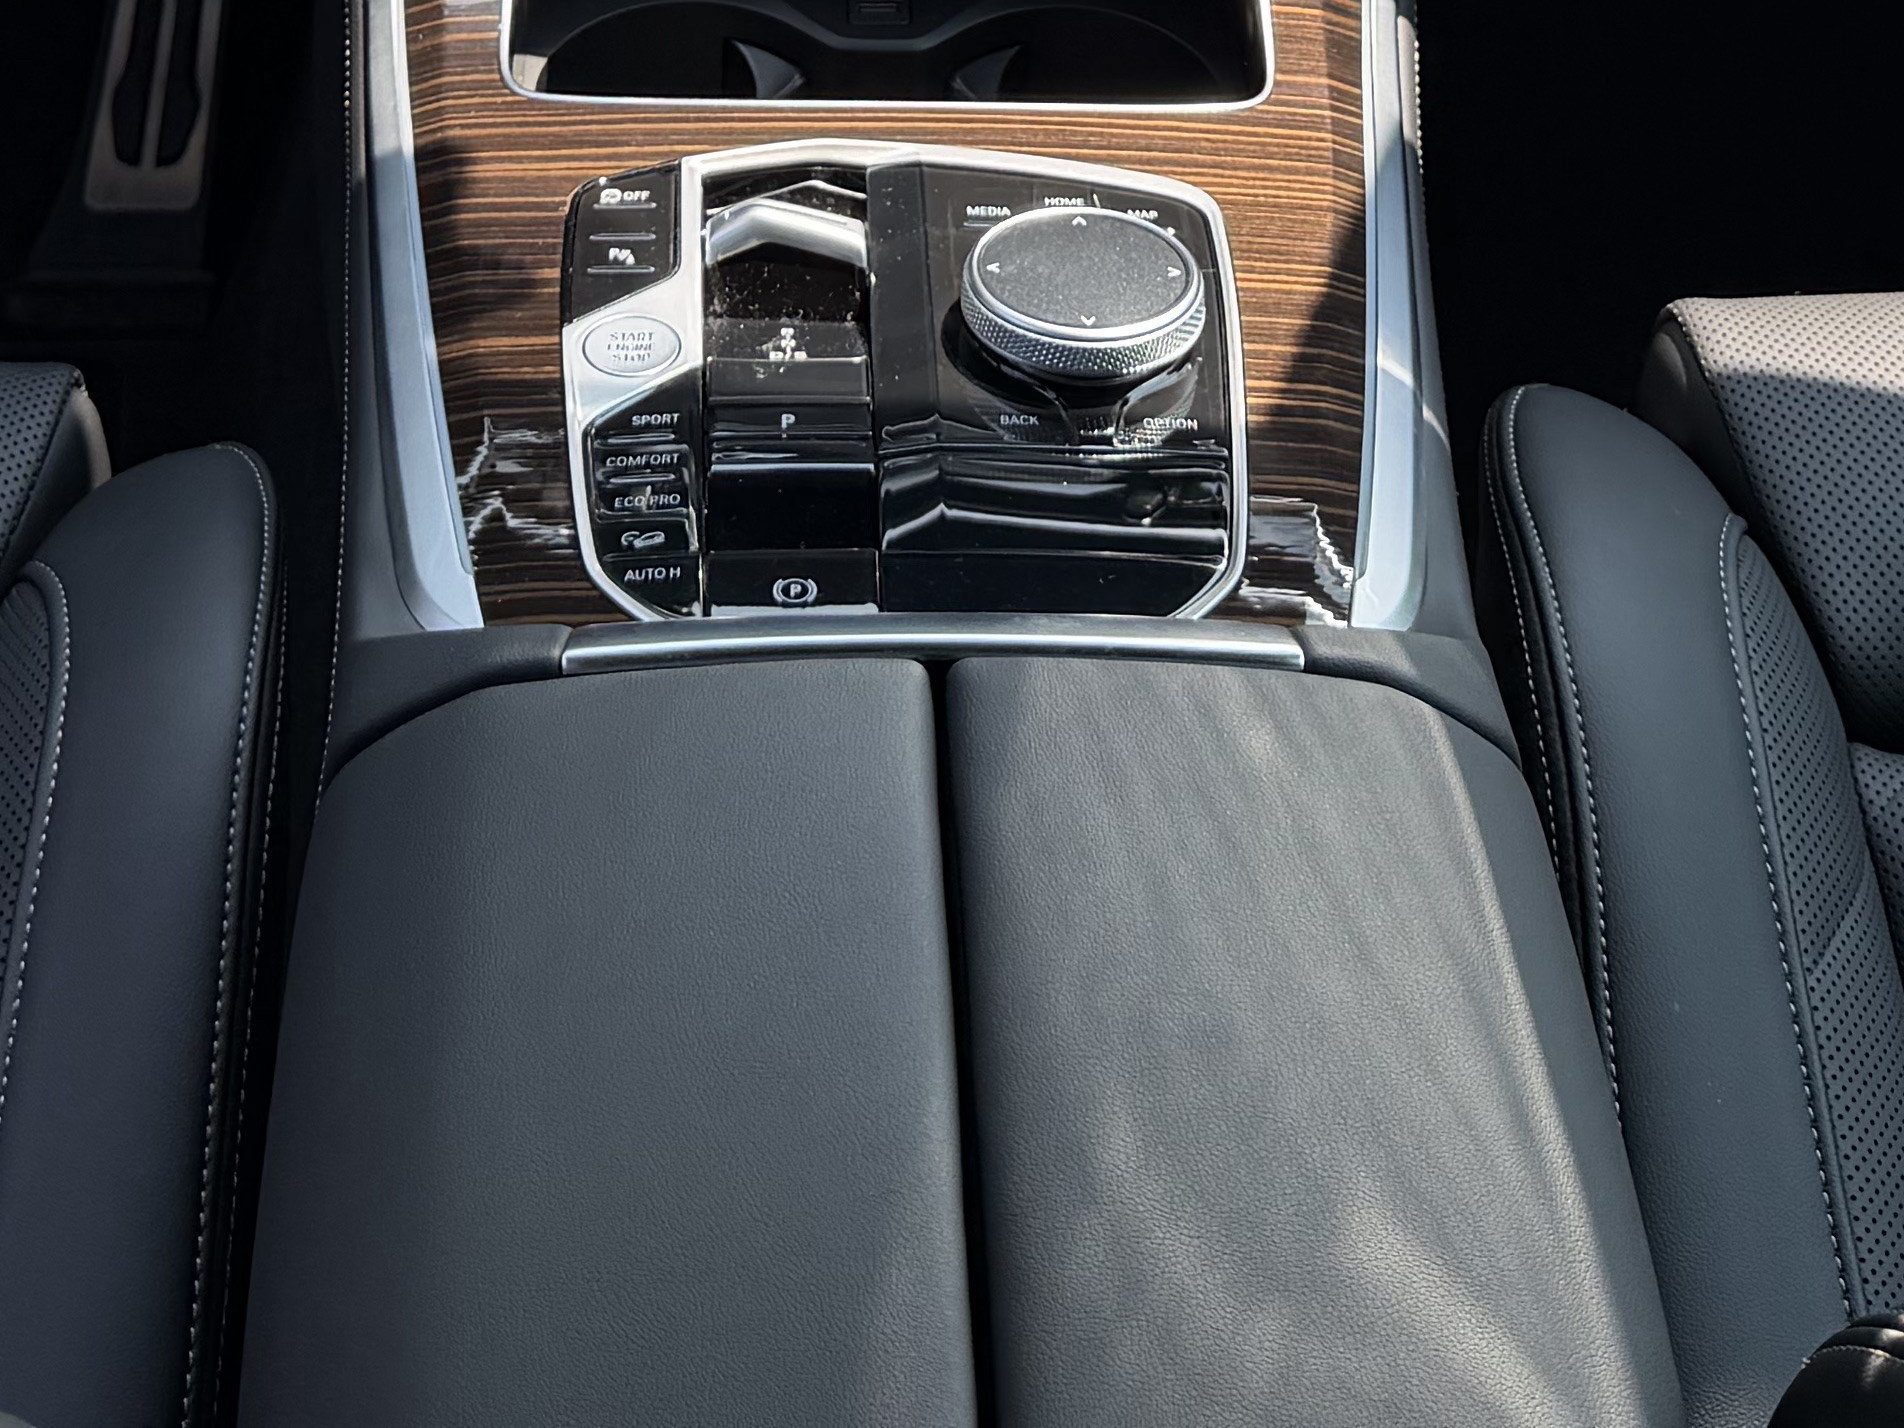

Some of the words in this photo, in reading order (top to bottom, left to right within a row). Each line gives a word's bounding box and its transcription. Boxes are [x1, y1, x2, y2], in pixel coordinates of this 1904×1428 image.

[623, 190, 651, 202] OFF
[1045, 197, 1086, 206] HOME
[966, 205, 1012, 217] MEDIA
[1127, 209, 1159, 220] MAP
[609, 331, 656, 342] START
[607, 342, 656, 352] ENGINE
[611, 352, 651, 362] STOP
[632, 413, 681, 426] SPORT
[781, 413, 796, 429] P
[1000, 414, 1040, 426] BACK
[1143, 417, 1198, 430] OPTION
[606, 452, 680, 467] COMFORT
[614, 495, 645, 508] ECO
[648, 494, 681, 507] PRO
[623, 567, 666, 582] AUTO
[669, 566, 682, 578] H
